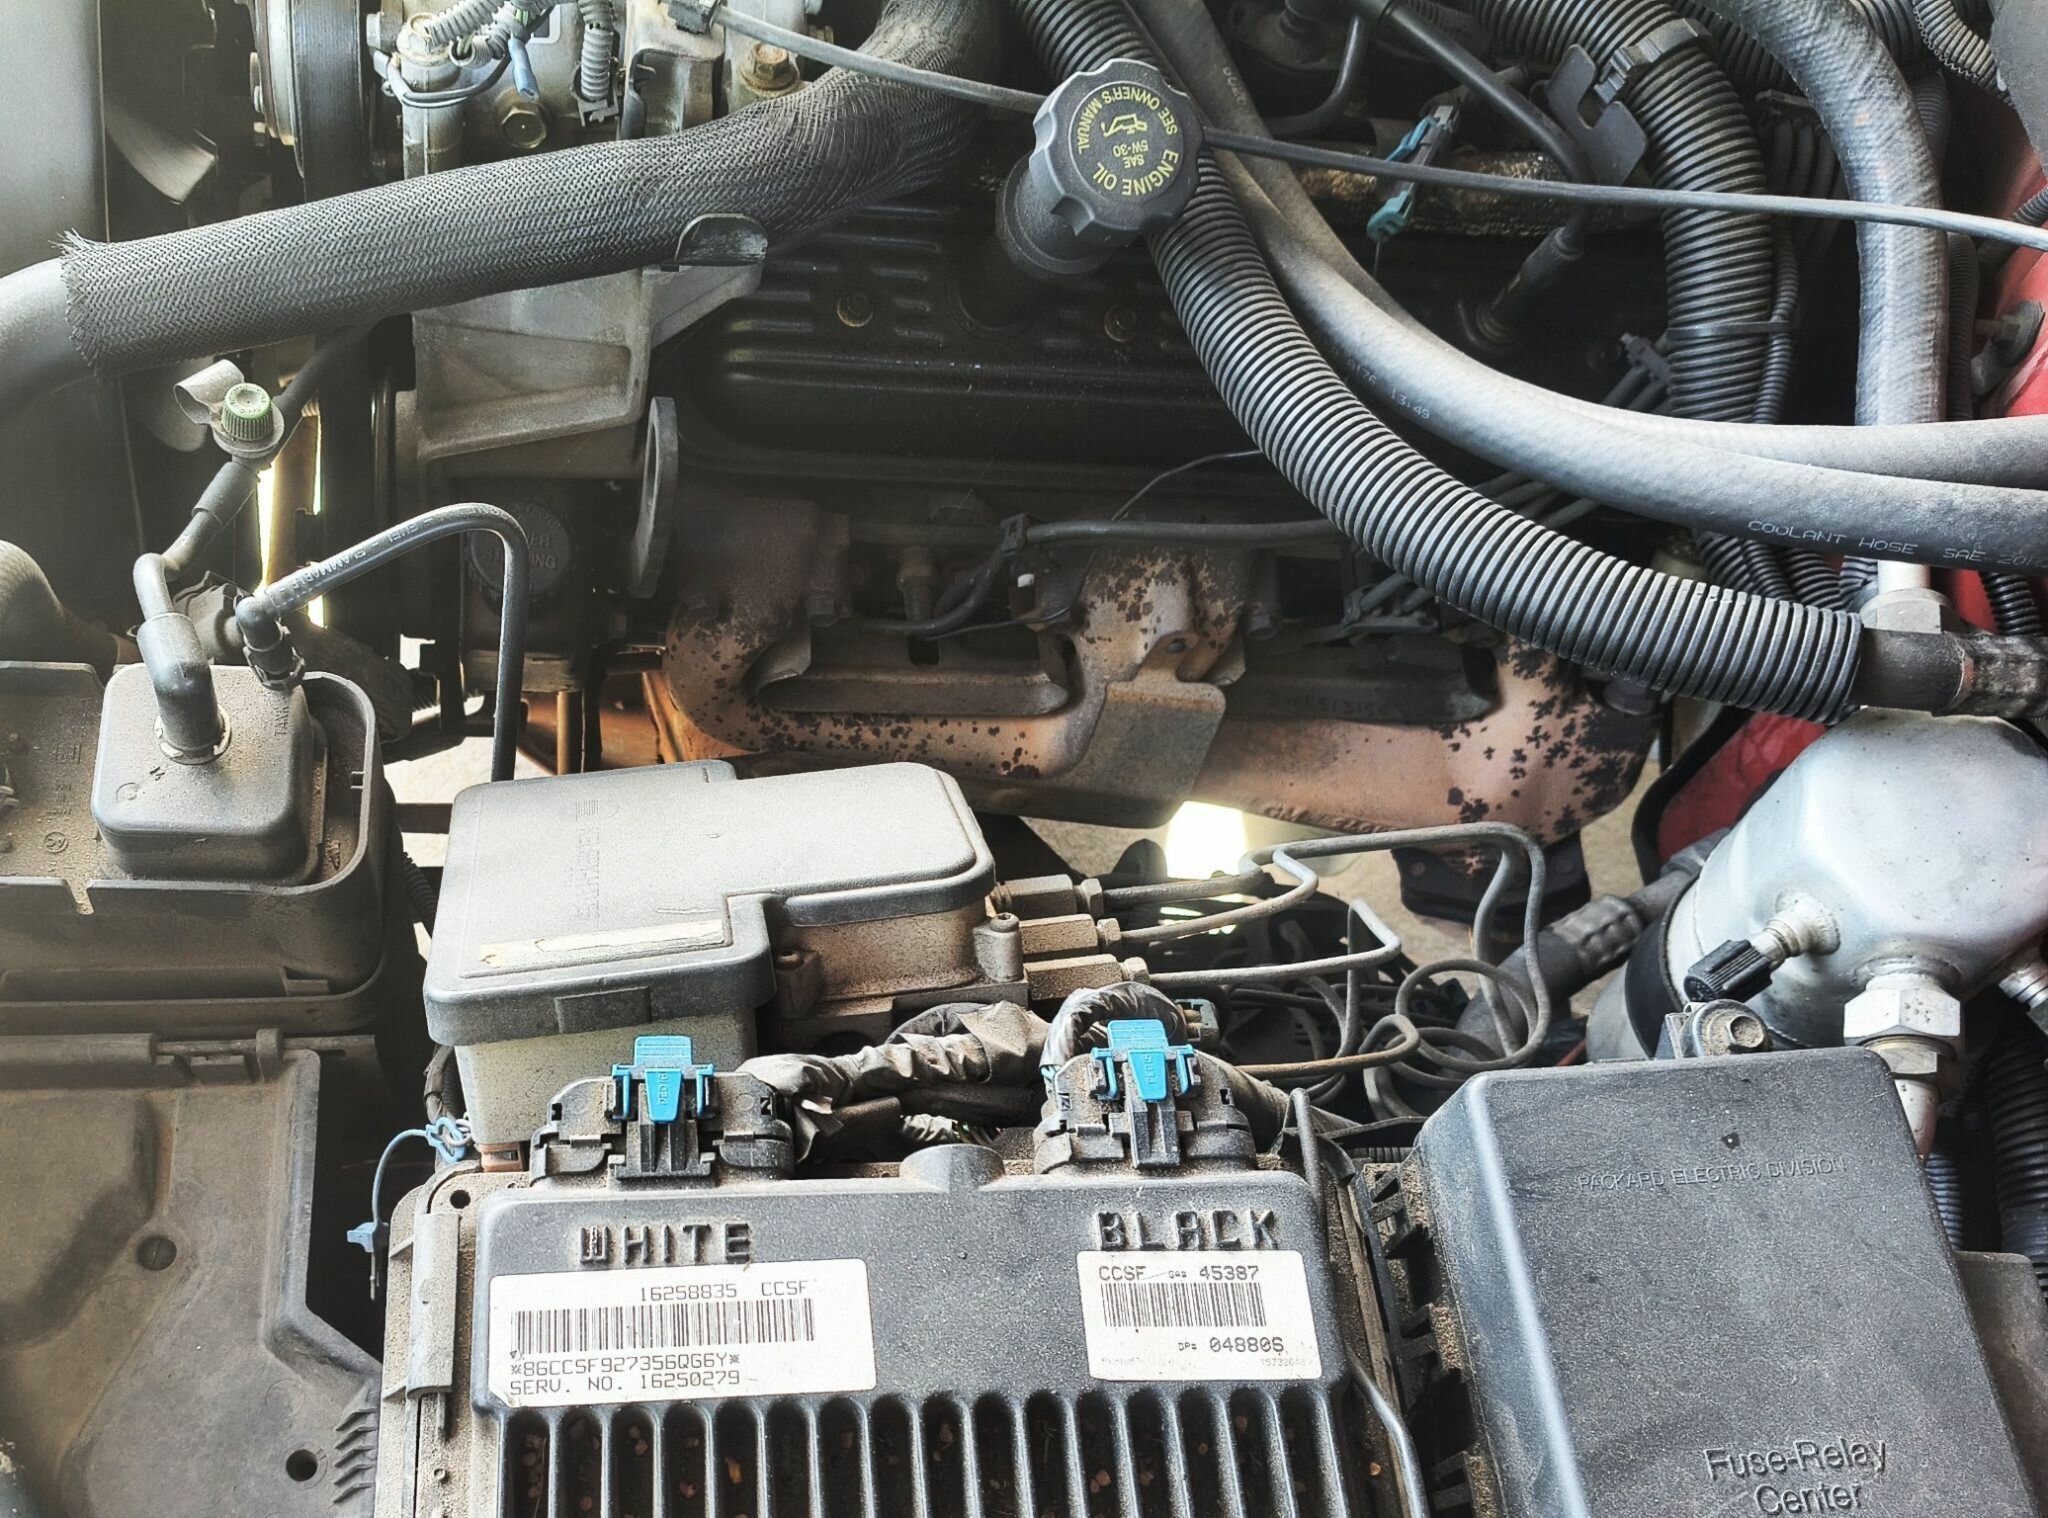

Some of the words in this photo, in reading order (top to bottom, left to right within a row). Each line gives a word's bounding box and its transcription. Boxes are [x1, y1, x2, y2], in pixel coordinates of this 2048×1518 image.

[1102, 86, 1161, 110] OWNER'S
[1077, 97, 1103, 155] MANUAL
[1158, 107, 1178, 136] SEE
[1112, 139, 1149, 158] 5W-30
[1122, 154, 1145, 169] SAE
[1092, 162, 1118, 191] OIL
[1121, 149, 1179, 196] ENGINE
[1748, 520, 1847, 545] COOLANT
[1858, 536, 1920, 555] HOSE
[1943, 547, 1987, 563] SAE
[1577, 1171, 1665, 1190] PACKARD
[1670, 1163, 1761, 1185] ELECTRIC
[1766, 1157, 1847, 1178] DIVISION
[579, 1222, 752, 1266] WHITE
[1096, 1210, 1279, 1250] BLACK
[1099, 1265, 1147, 1281] CCSF
[1199, 1265, 1260, 1281] 45387
[640, 1282, 738, 1302] 16258835
[761, 1280, 809, 1298] CCSF
[510, 1378, 572, 1396] SERV.
[588, 1375, 623, 1392] NO.
[640, 1369, 740, 1390] 16250279
[1703, 1436, 1887, 1482] Fuse-Relay
[1754, 1481, 1863, 1516] Center
